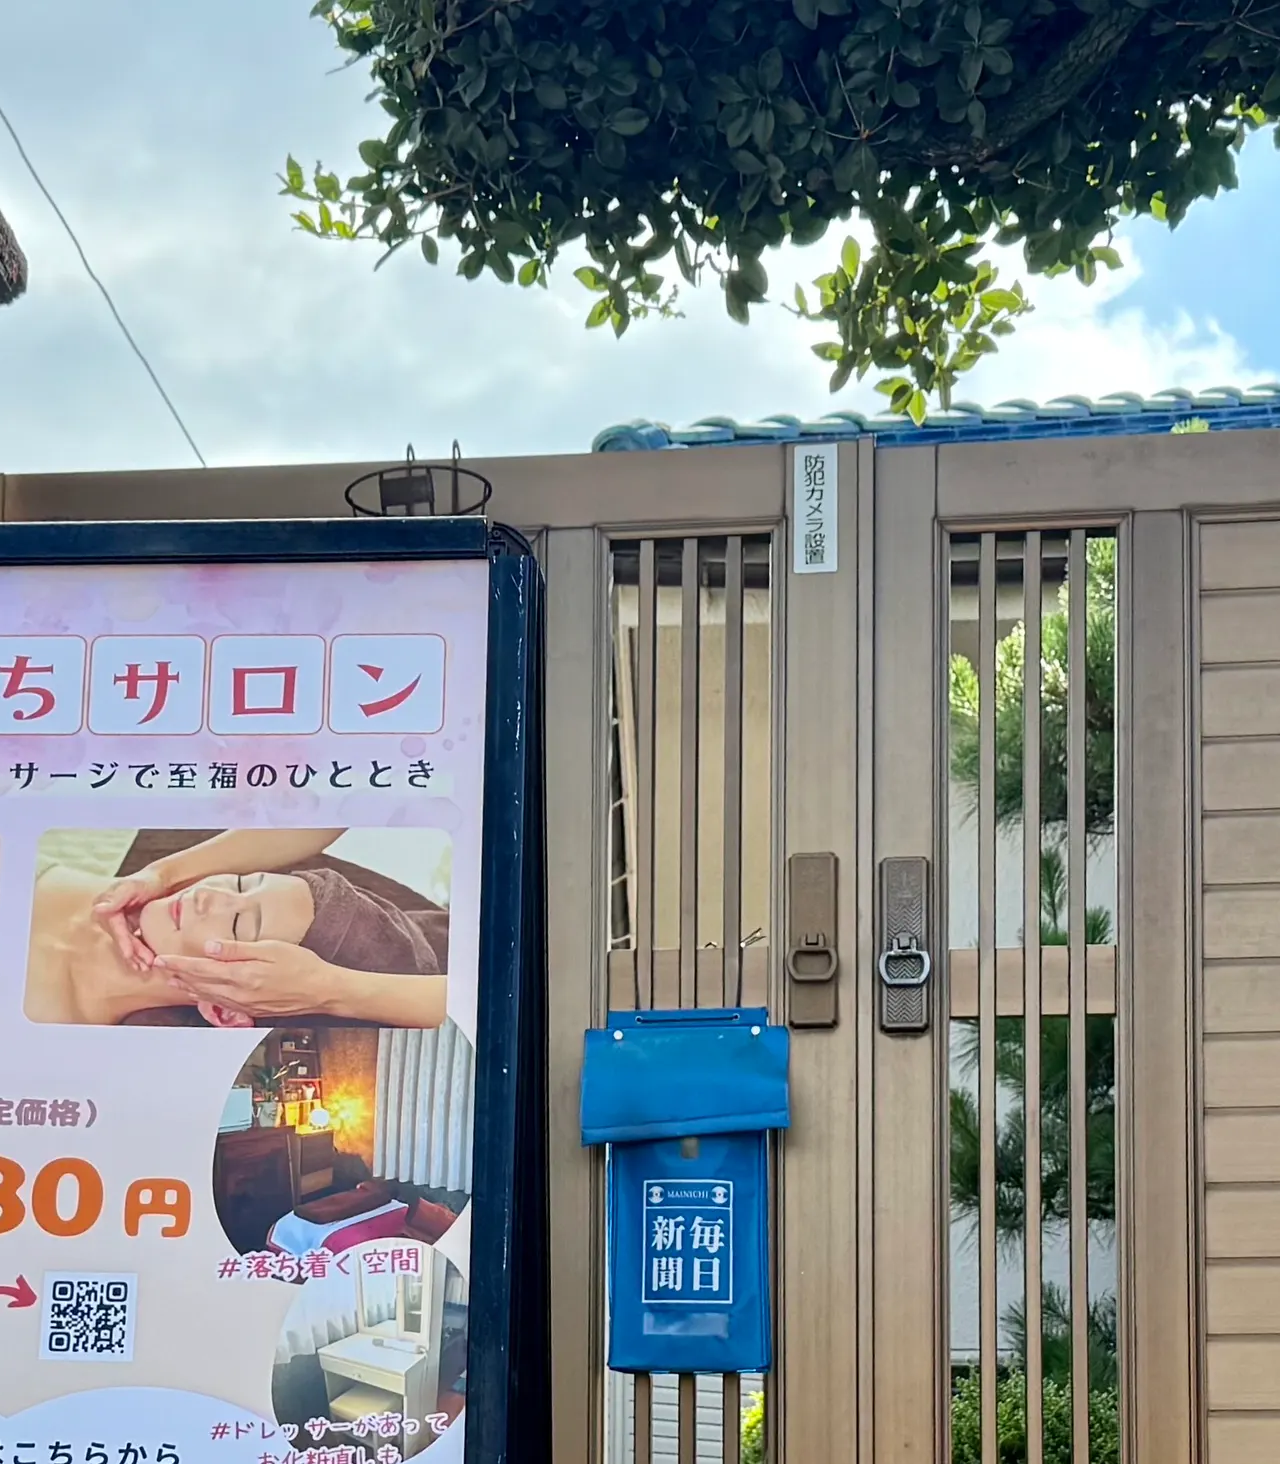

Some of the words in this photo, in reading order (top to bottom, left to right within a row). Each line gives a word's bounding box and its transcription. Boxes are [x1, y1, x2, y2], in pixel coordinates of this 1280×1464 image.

[804, 454, 825, 565] 防犯カメラ設置
[218, 1248, 420, 1279] #落ち着く空間
[210, 1412, 449, 1440] #ドレッサーがあって
